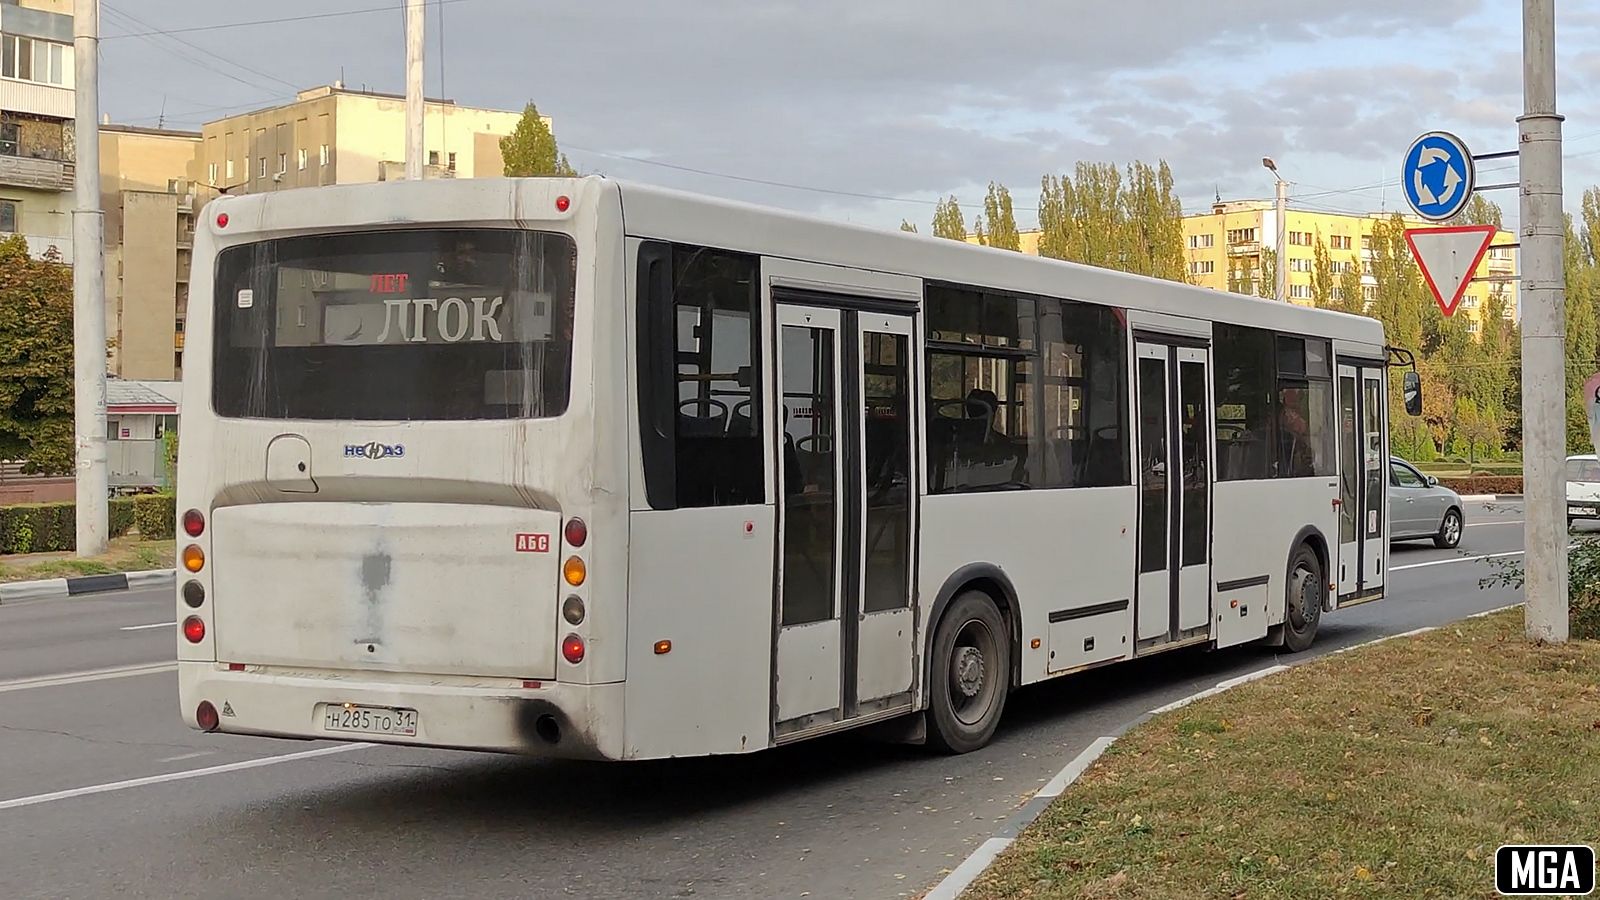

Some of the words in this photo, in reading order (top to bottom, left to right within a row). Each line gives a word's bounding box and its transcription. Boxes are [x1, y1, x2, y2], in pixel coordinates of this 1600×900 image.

[370, 273, 409, 293] ЛЕТ
[377, 296, 503, 342] ЛГОК
[517, 535, 548, 551] АБС
[396, 711, 412, 727] 31
